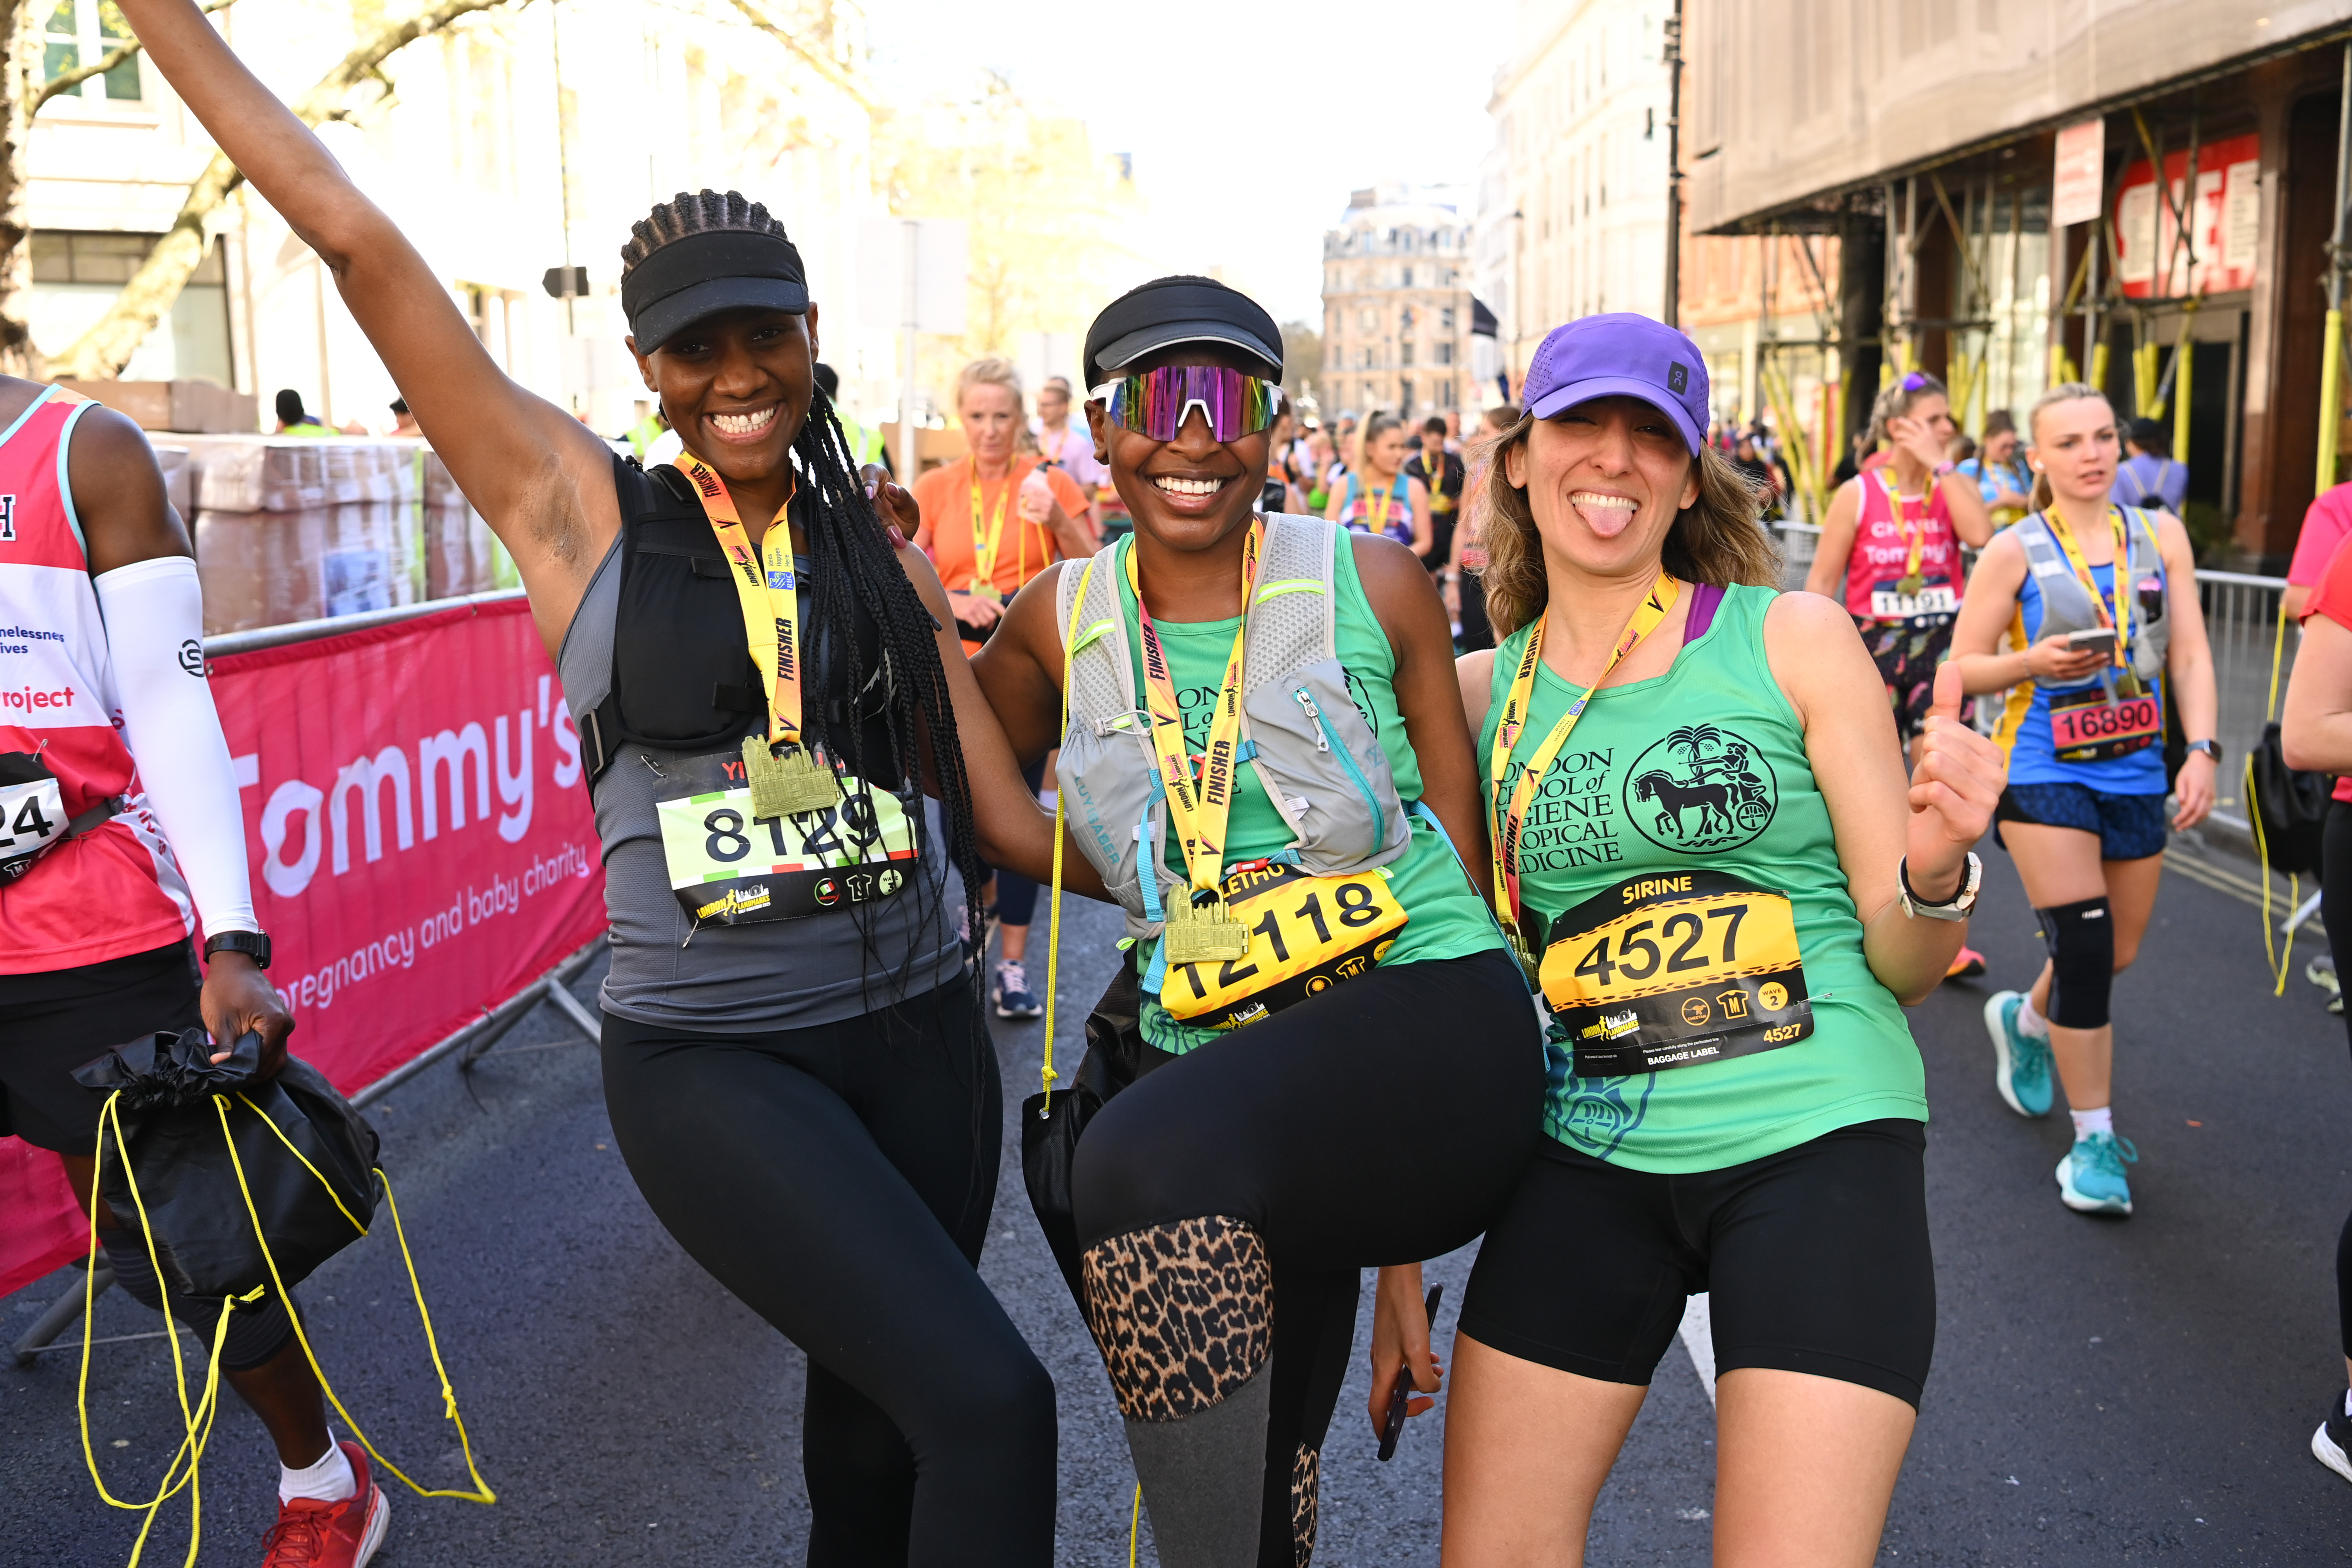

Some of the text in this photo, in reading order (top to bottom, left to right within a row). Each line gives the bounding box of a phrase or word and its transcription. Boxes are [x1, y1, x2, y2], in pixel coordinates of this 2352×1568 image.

[690, 462, 721, 498] FINISHER
[742, 566, 760, 586] LONDON
[776, 617, 794, 681] FINISHER
[1143, 623, 1166, 681] FINISHER
[1518, 629, 1541, 679] FINISHER
[0, 686, 74, 713] roject
[1228, 693, 1236, 717] LONDON
[1508, 699, 1516, 719] LONDON
[2062, 702, 2152, 738] 16890
[1170, 754, 1184, 778] LANDMARKS
[1207, 740, 1230, 806] FINISHER
[1502, 747, 1615, 783] ONDON
[1586, 769, 1611, 794] of
[1176, 787, 1194, 812] LONDON
[704, 793, 879, 863] 8129
[1505, 814, 1519, 877] FINISHER
[1498, 867, 1506, 892] LONDON
[1622, 876, 1692, 905] SIRINE
[422, 891, 463, 950] and
[468, 874, 520, 925] baby
[523, 842, 591, 897] charity
[696, 895, 770, 919] LONDON LANDMARKS
[1574, 904, 1748, 986] 4527
[1347, 964, 1359, 976] M
[1728, 996, 1740, 1013] M
[1762, 988, 1782, 996] WAVE
[1769, 996, 1779, 1006] 2
[1209, 1020, 1232, 1029] NDON
[1240, 1008, 1268, 1026] LANDMARKS
[1581, 1019, 1639, 1038] LONDON LANDMARKS
[1763, 1023, 1802, 1043] 4527
[1647, 1047, 1720, 1065] BAGGAGE LABEL
